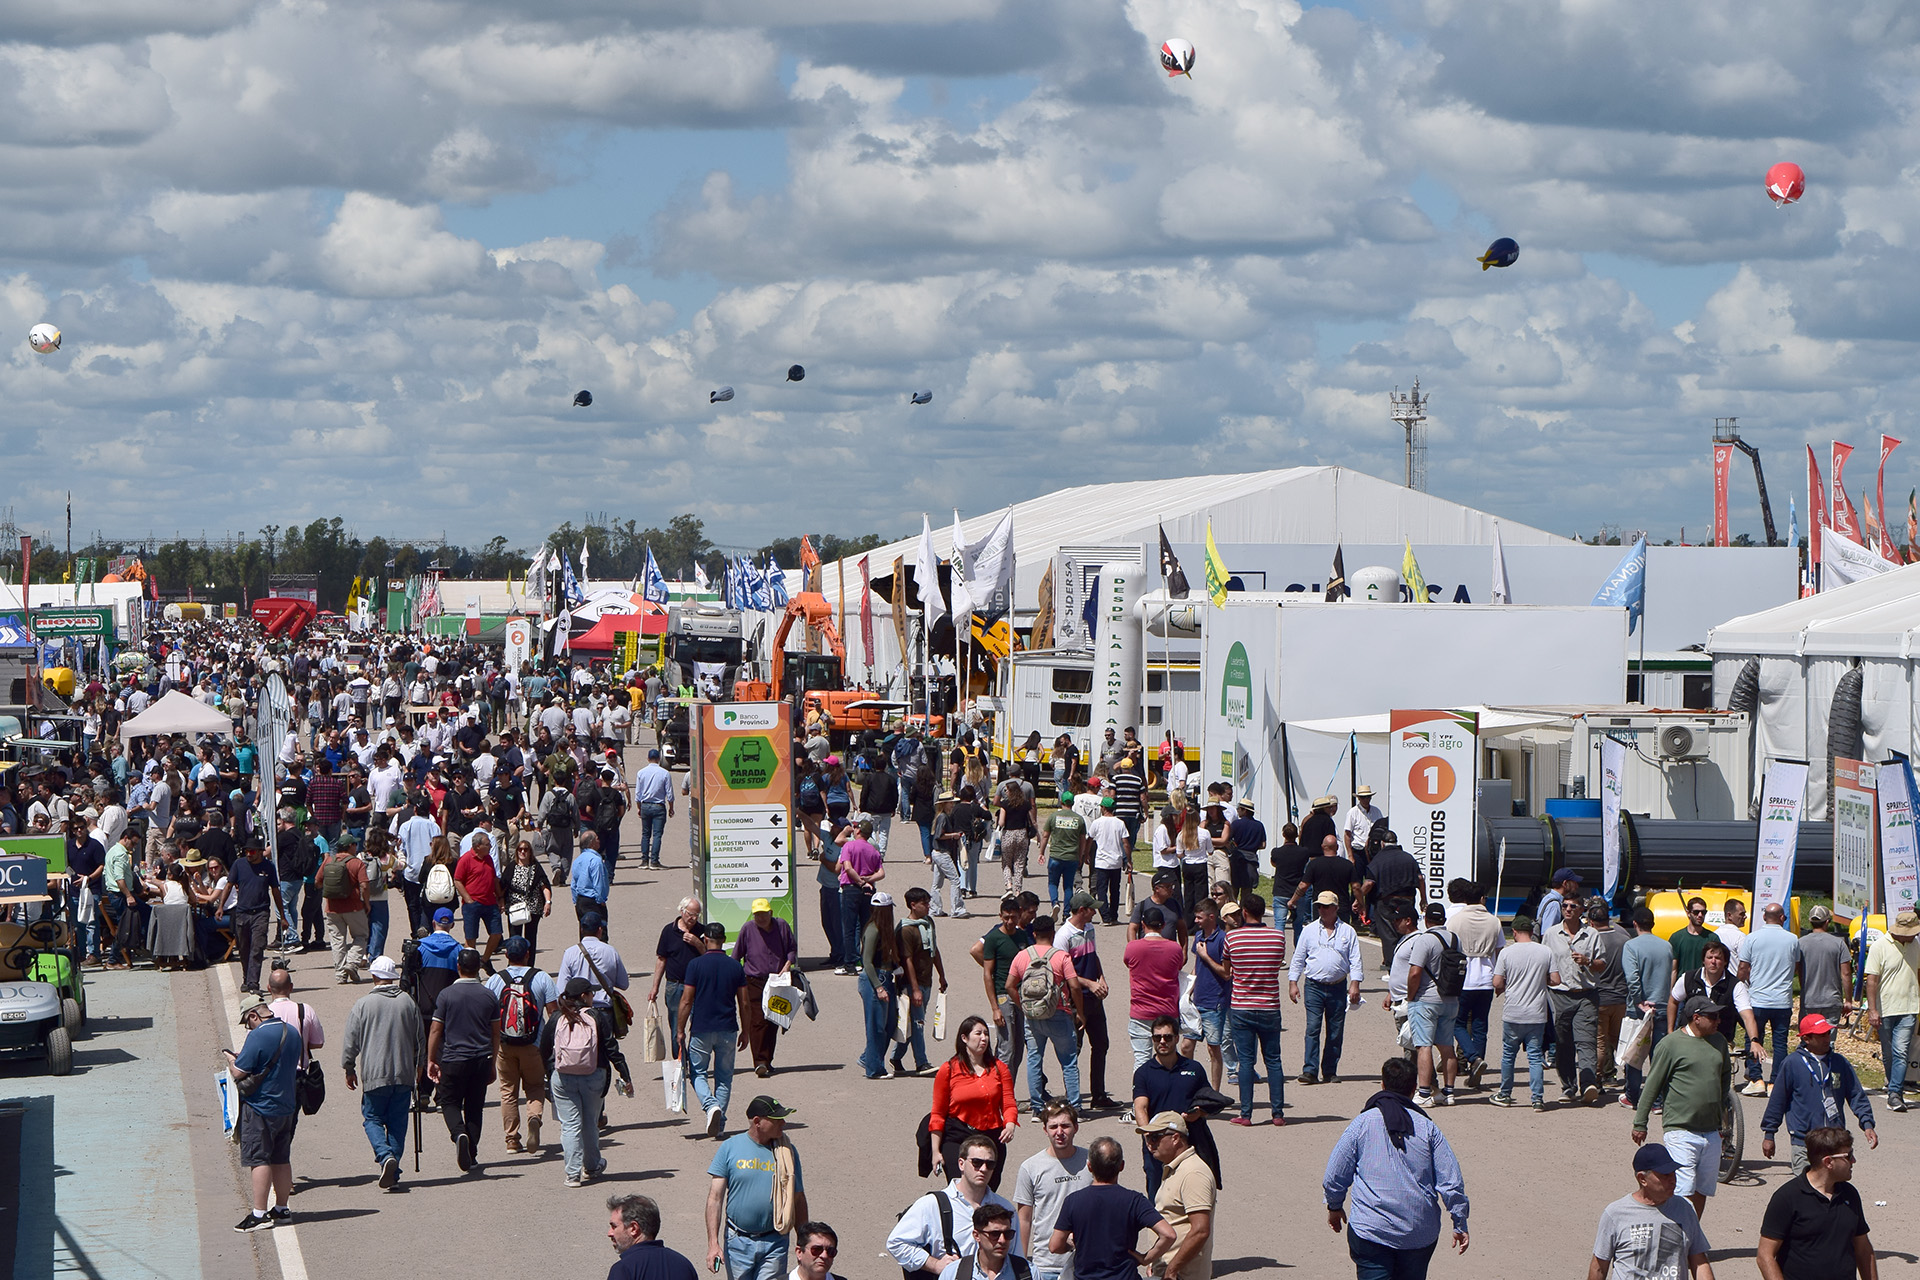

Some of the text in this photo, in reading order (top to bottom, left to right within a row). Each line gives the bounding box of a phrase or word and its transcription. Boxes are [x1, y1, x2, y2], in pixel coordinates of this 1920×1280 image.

[1065, 561, 1074, 616] SIDERSA
[514, 633, 522, 643] 2
[1402, 739, 1463, 751] Expoagro agro
[730, 769, 766, 778] PARADA
[1423, 766, 1439, 795] 1
[713, 816, 754, 825] TECNÓDROMO
[1429, 810, 1446, 900] CUBIERTOS
[1662, 1265, 1679, 1277] 06
